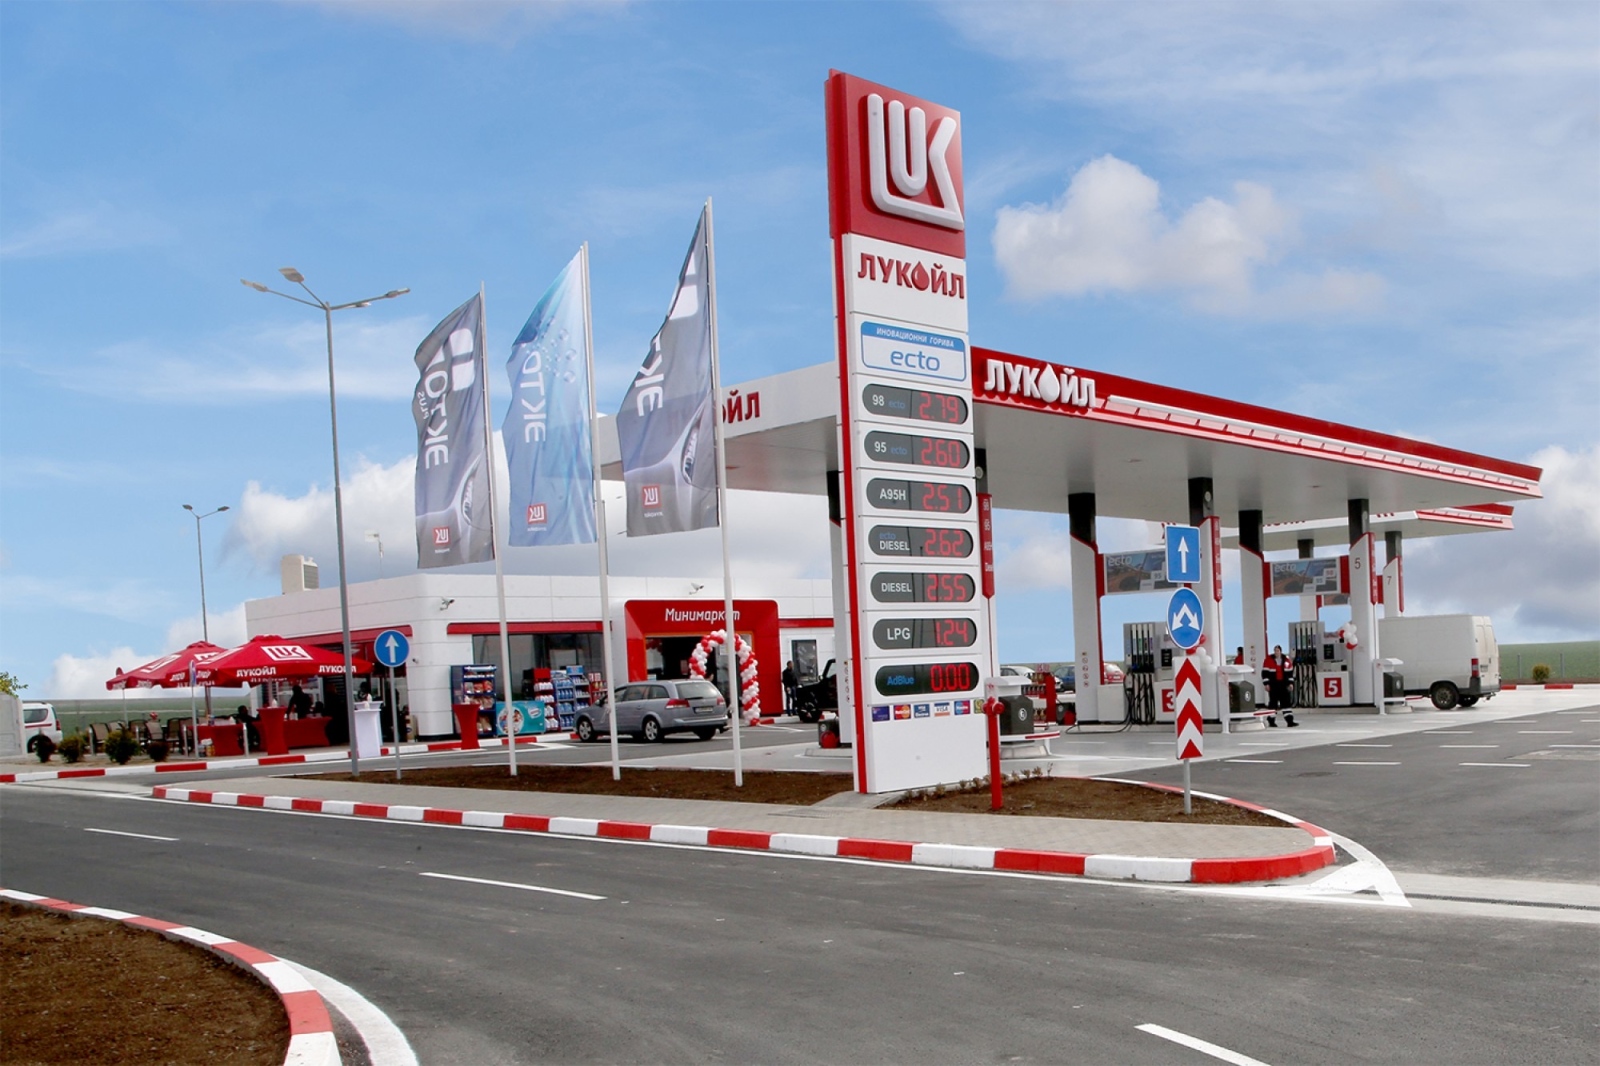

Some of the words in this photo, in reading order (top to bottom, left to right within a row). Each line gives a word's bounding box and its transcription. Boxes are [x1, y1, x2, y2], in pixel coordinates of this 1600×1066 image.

[857, 252, 965, 299] ЛУКОЙЛ
[876, 327, 927, 343] ИНОВАЦИОННИ
[929, 336, 954, 348] ГОРИВА
[890, 350, 940, 371] ecto
[984, 357, 1096, 408] ЛУКОЙЛ
[722, 389, 760, 424] ЙЛ
[872, 394, 885, 407] 98
[919, 392, 959, 423] 2.79
[874, 440, 887, 453] 95
[921, 437, 961, 467] 2.60
[879, 487, 906, 501] A95H
[922, 483, 963, 511] 2.51
[878, 531, 896, 541] ecto
[879, 540, 910, 551] DIESEL
[924, 528, 964, 556] 2.62
[1107, 555, 1133, 567] ecto
[1274, 561, 1297, 573] ecto
[1354, 557, 1361, 570] 5
[881, 582, 912, 593] DIESEL
[926, 574, 966, 601] 2.55
[1387, 575, 1392, 585] 7
[665, 608, 741, 625] Минимаркт
[886, 627, 911, 641] LPG
[935, 619, 969, 646] 1.24
[236, 665, 276, 678] ЛУКОЙЛ
[318, 664, 357, 674] ЛУКОЛ
[886, 676, 915, 686] AdBlue
[930, 663, 970, 691] 0.00
[1327, 679, 1339, 695] 5
[1166, 691, 1174, 710] 3
